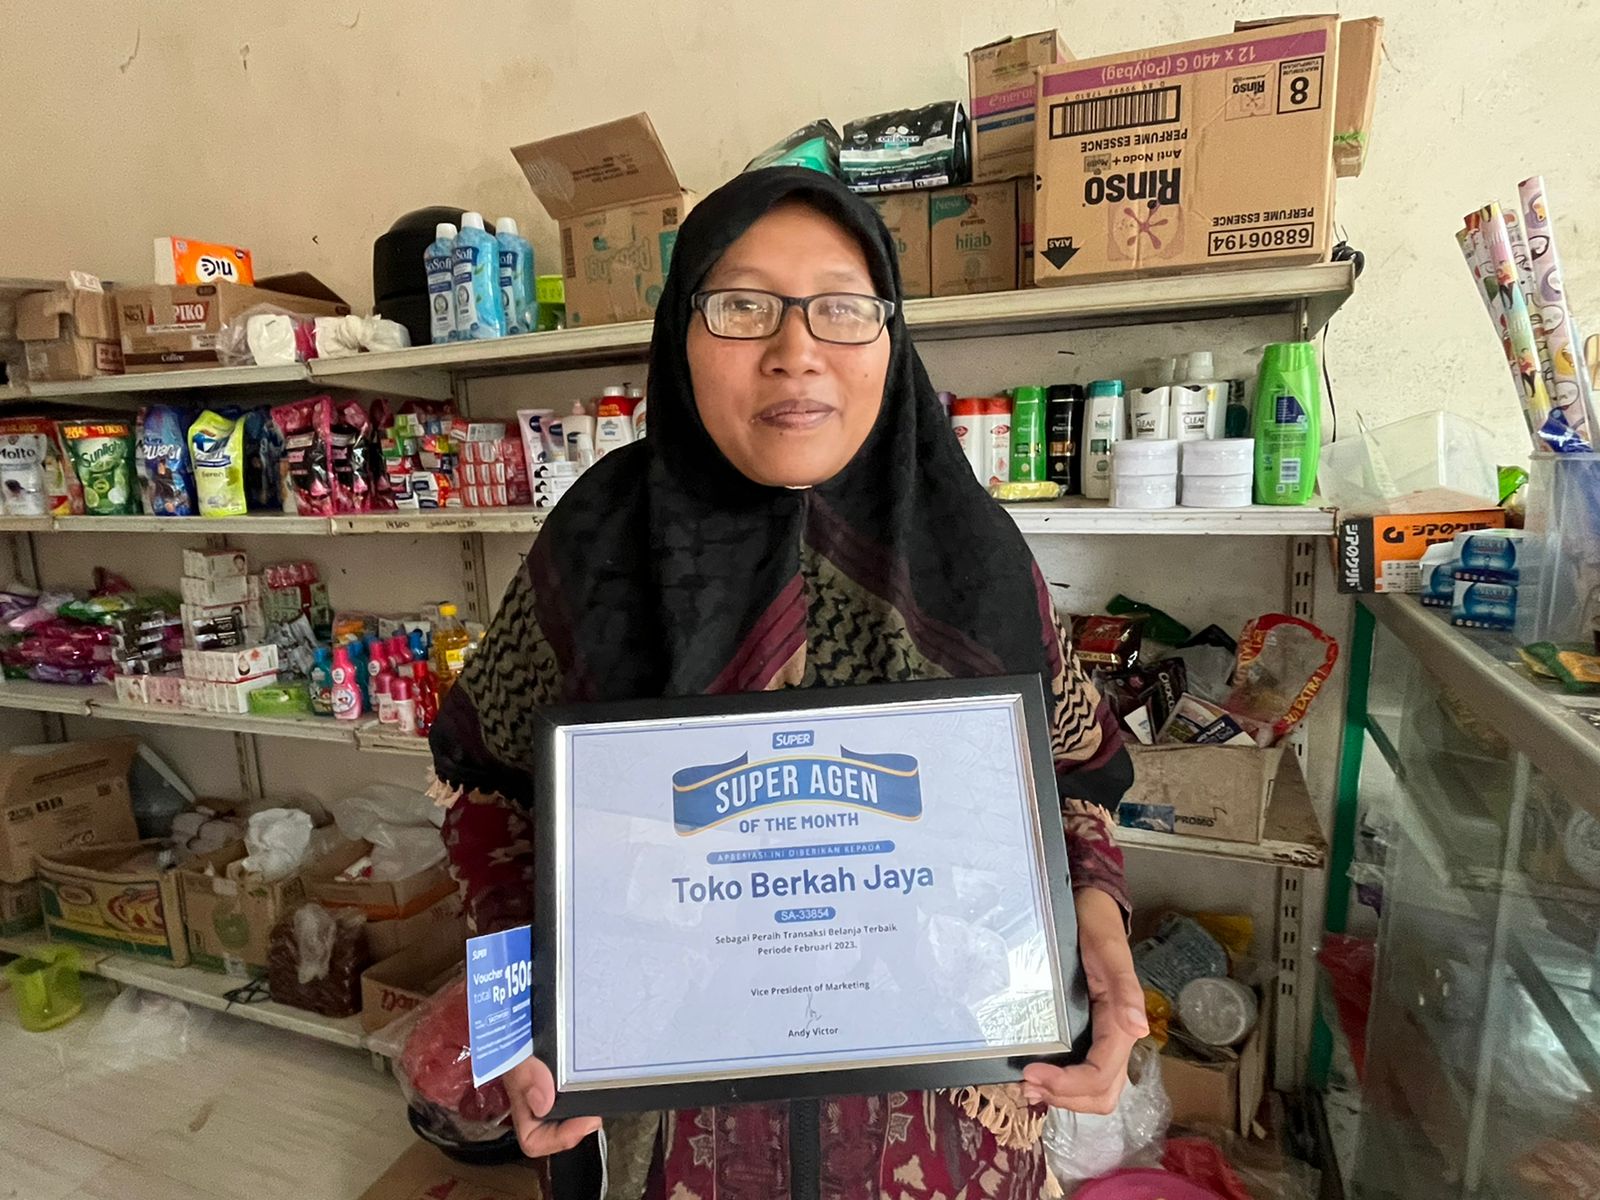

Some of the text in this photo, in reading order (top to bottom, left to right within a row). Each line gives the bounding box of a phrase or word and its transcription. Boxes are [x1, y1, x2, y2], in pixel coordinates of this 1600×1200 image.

[1101, 45, 1256, 83] 12 x 440 G (Polybag)
[1232, 80, 1266, 96] Rinso
[1290, 76, 1309, 105] 8
[1080, 128, 1188, 153] PERFUME ESSENCE
[1123, 153, 1154, 164] Noda
[1157, 149, 1182, 162] Anti
[1084, 167, 1182, 209] Rinso
[1213, 206, 1315, 226] PERFUME ESSENCE
[1048, 238, 1072, 249] ATAS
[1213, 227, 1310, 252] 68806194
[161, 353, 185, 363] Coffee
[1183, 416, 1205, 426] CLEAR
[1297, 675, 1322, 711] EXTRA
[776, 733, 811, 747] SUPER
[715, 764, 878, 814] SUPER AGEN
[739, 812, 859, 834] OF THE MONTH
[771, 850, 784, 859] INI
[789, 847, 840, 858] DIBERIKAN
[844, 843, 881, 854] KEPADA
[671, 864, 934, 904] Toko Berkah Jaya
[780, 908, 830, 921] SA-33854
[715, 923, 898, 947] Sebagai Peraih Transaksi Belanja Terbaik
[758, 941, 858, 956] Periode Februari 2023.
[473, 968, 504, 986] Voucher
[474, 988, 491, 1005] total
[751, 981, 871, 997] Vice President of Marketing
[788, 1027, 839, 1038] Andy Victor
